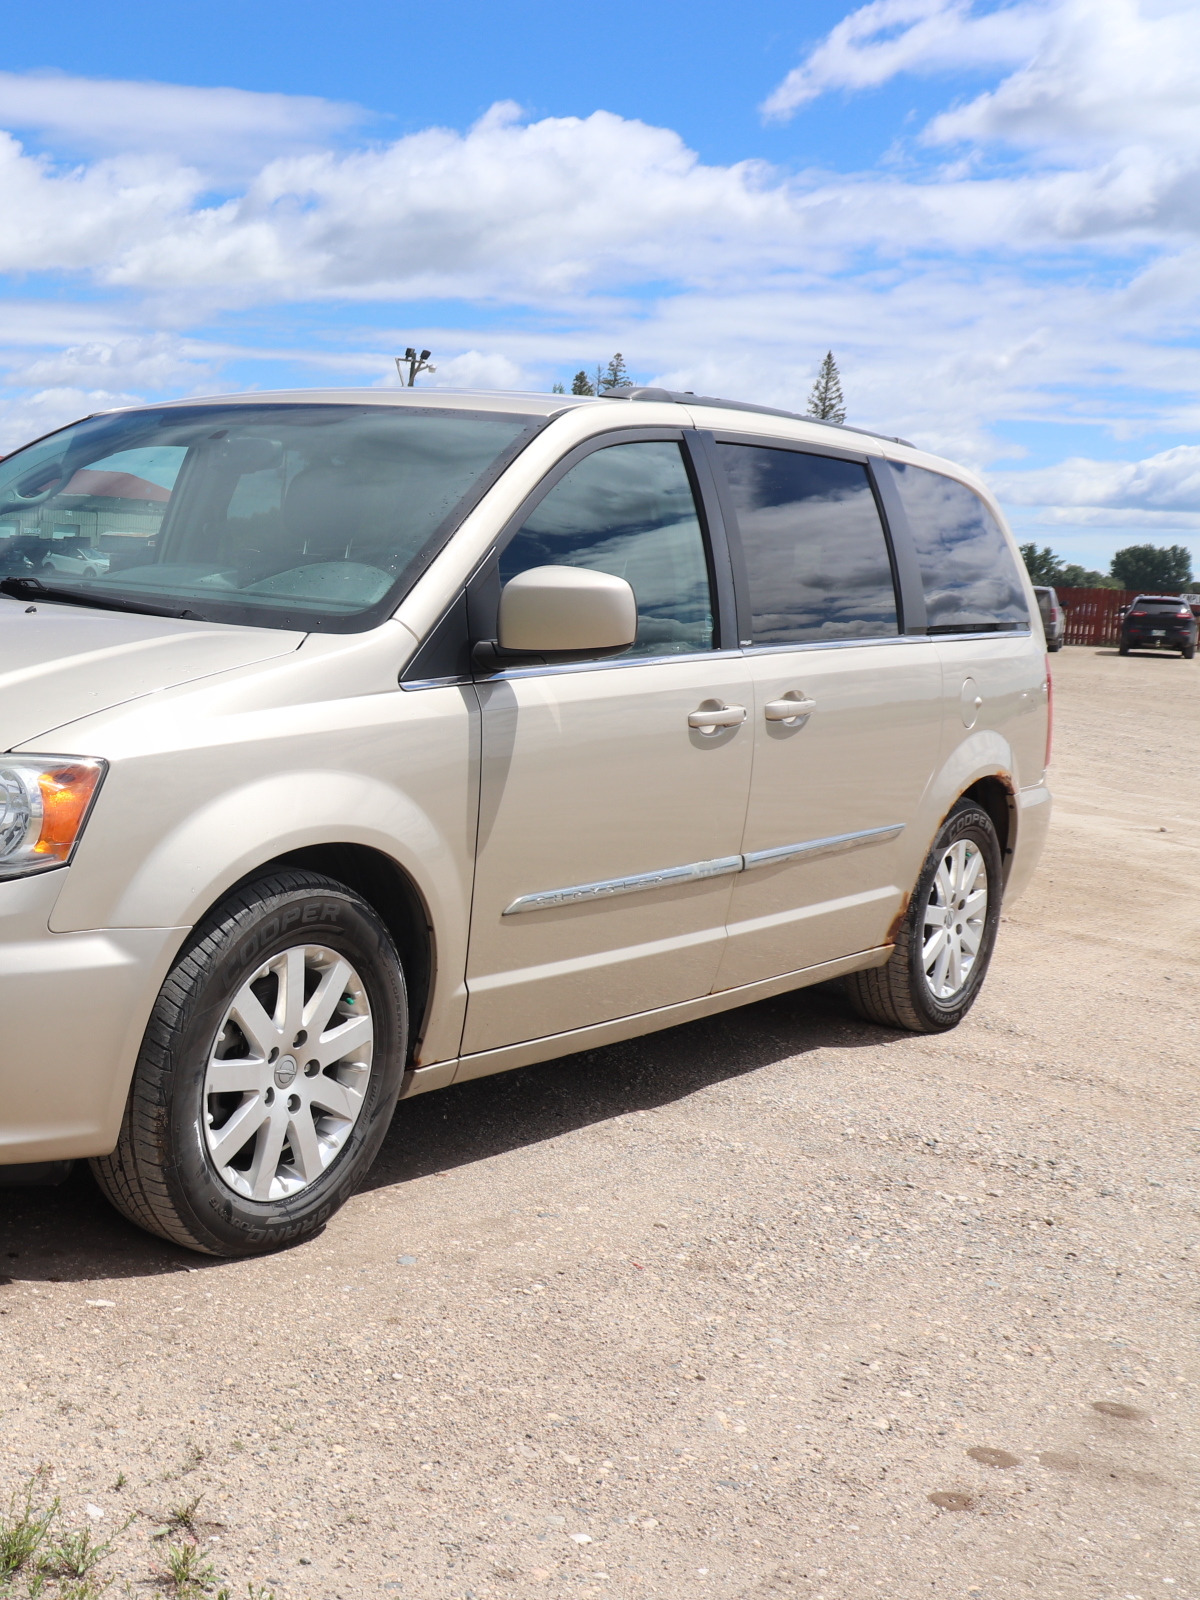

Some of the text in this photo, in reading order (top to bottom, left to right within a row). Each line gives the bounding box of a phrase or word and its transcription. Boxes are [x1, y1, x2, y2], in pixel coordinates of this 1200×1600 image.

[949, 813, 993, 842] COOPER
[535, 875, 663, 906] CHRYSLER
[221, 902, 341, 990] COOPER
